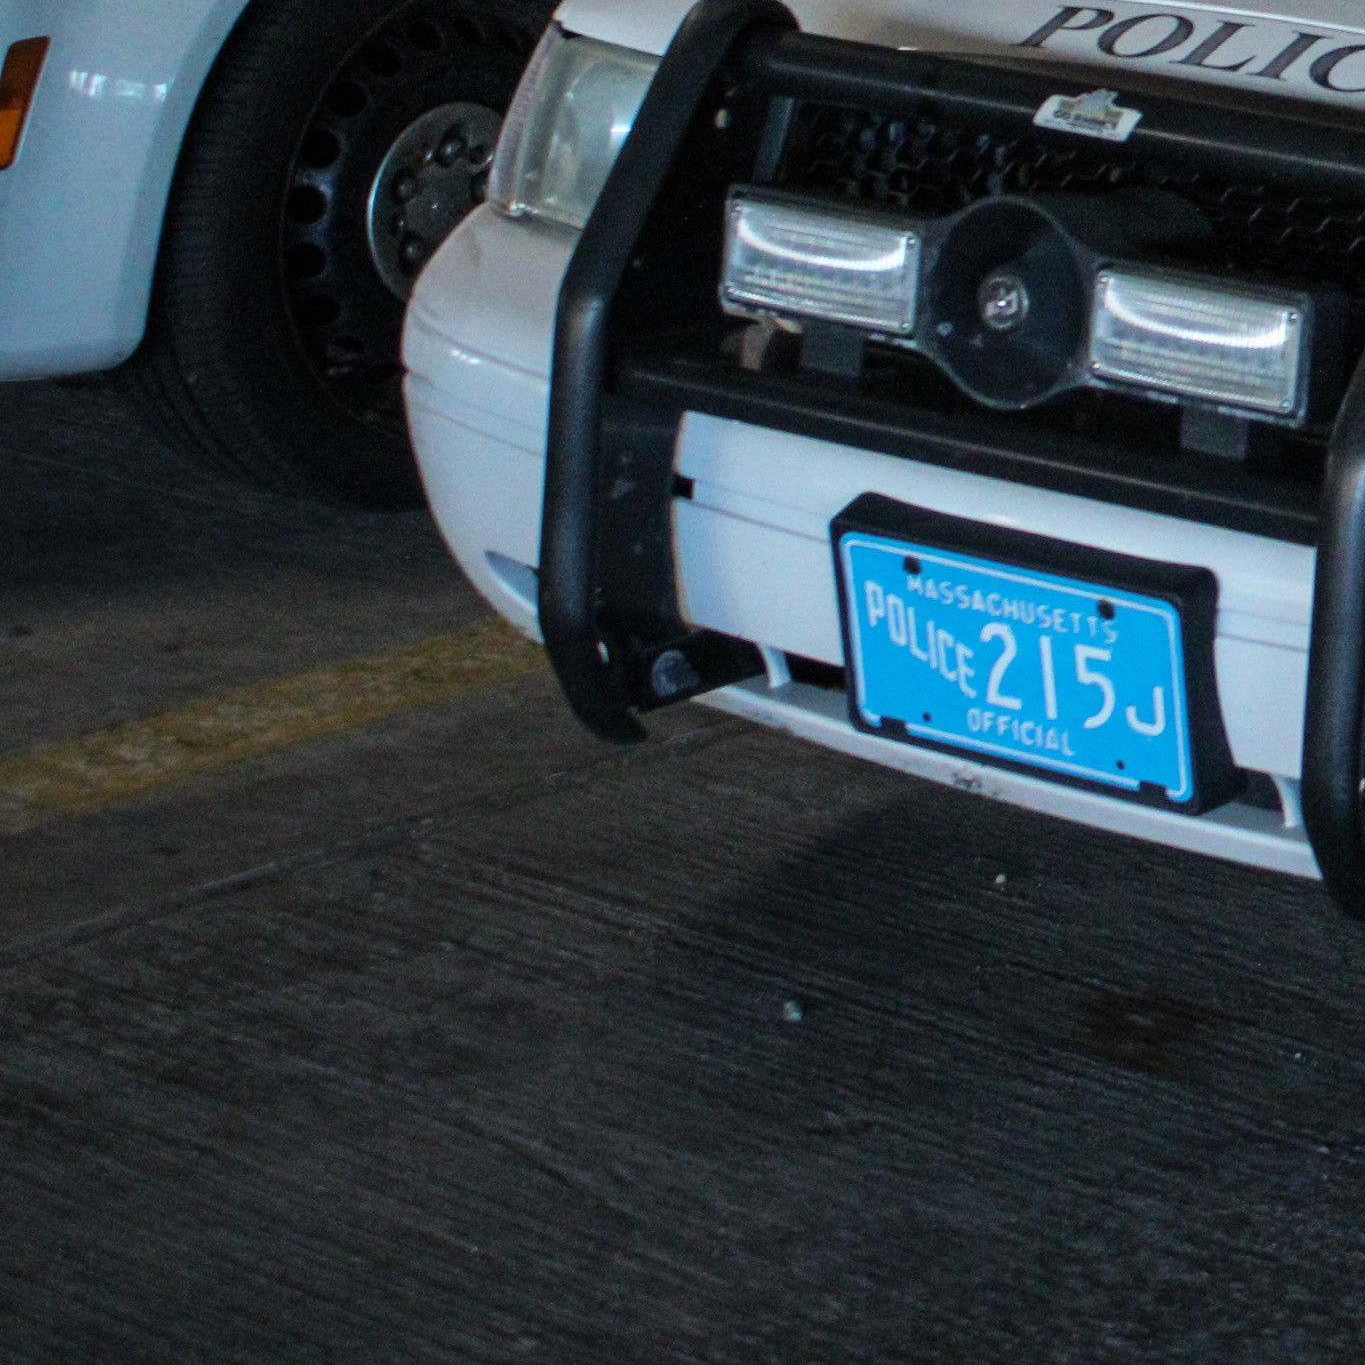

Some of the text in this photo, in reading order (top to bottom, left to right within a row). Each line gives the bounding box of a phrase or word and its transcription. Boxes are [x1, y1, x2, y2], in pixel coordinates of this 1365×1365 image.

[864, 580, 977, 699] POLICE
[906, 575, 1120, 645] MASSACHUSETTS
[966, 707, 1076, 757] OFFICIAL
